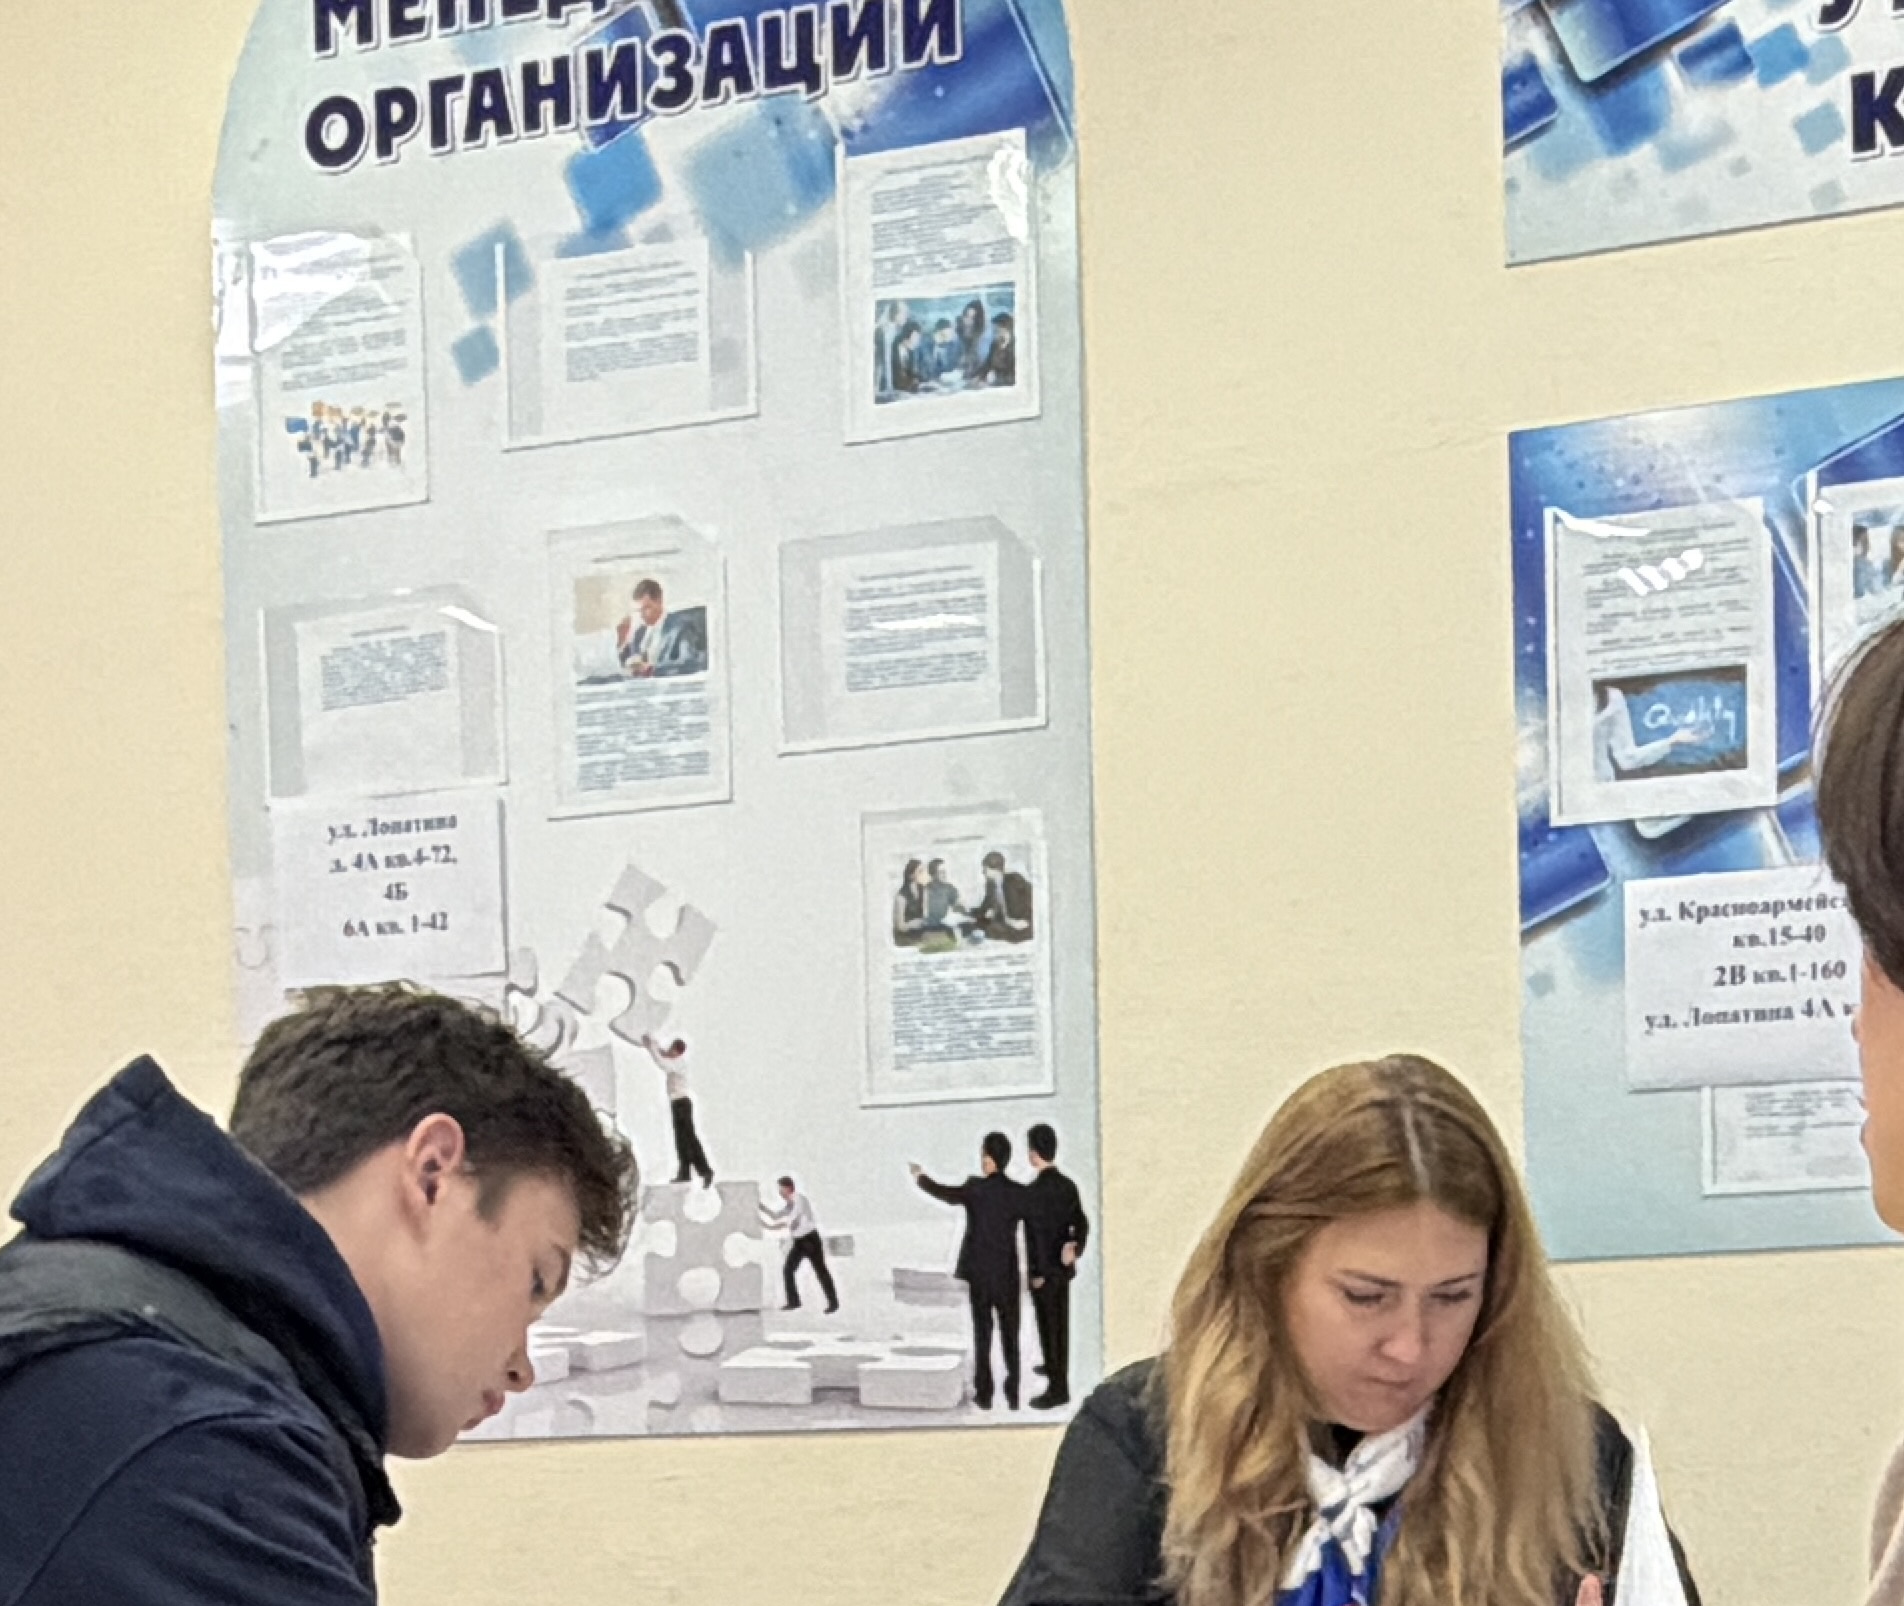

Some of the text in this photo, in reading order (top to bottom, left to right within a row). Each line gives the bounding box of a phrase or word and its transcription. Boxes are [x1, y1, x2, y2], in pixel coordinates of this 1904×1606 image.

[304, 0, 959, 169] ОРГАНИЗАЦИИ
[1639, 893, 1850, 929] ул. Красноармейс
[1713, 964, 1746, 987] 2В
[1644, 1014, 1678, 1035] ул.
[1683, 1004, 1794, 1028] Лопатина
